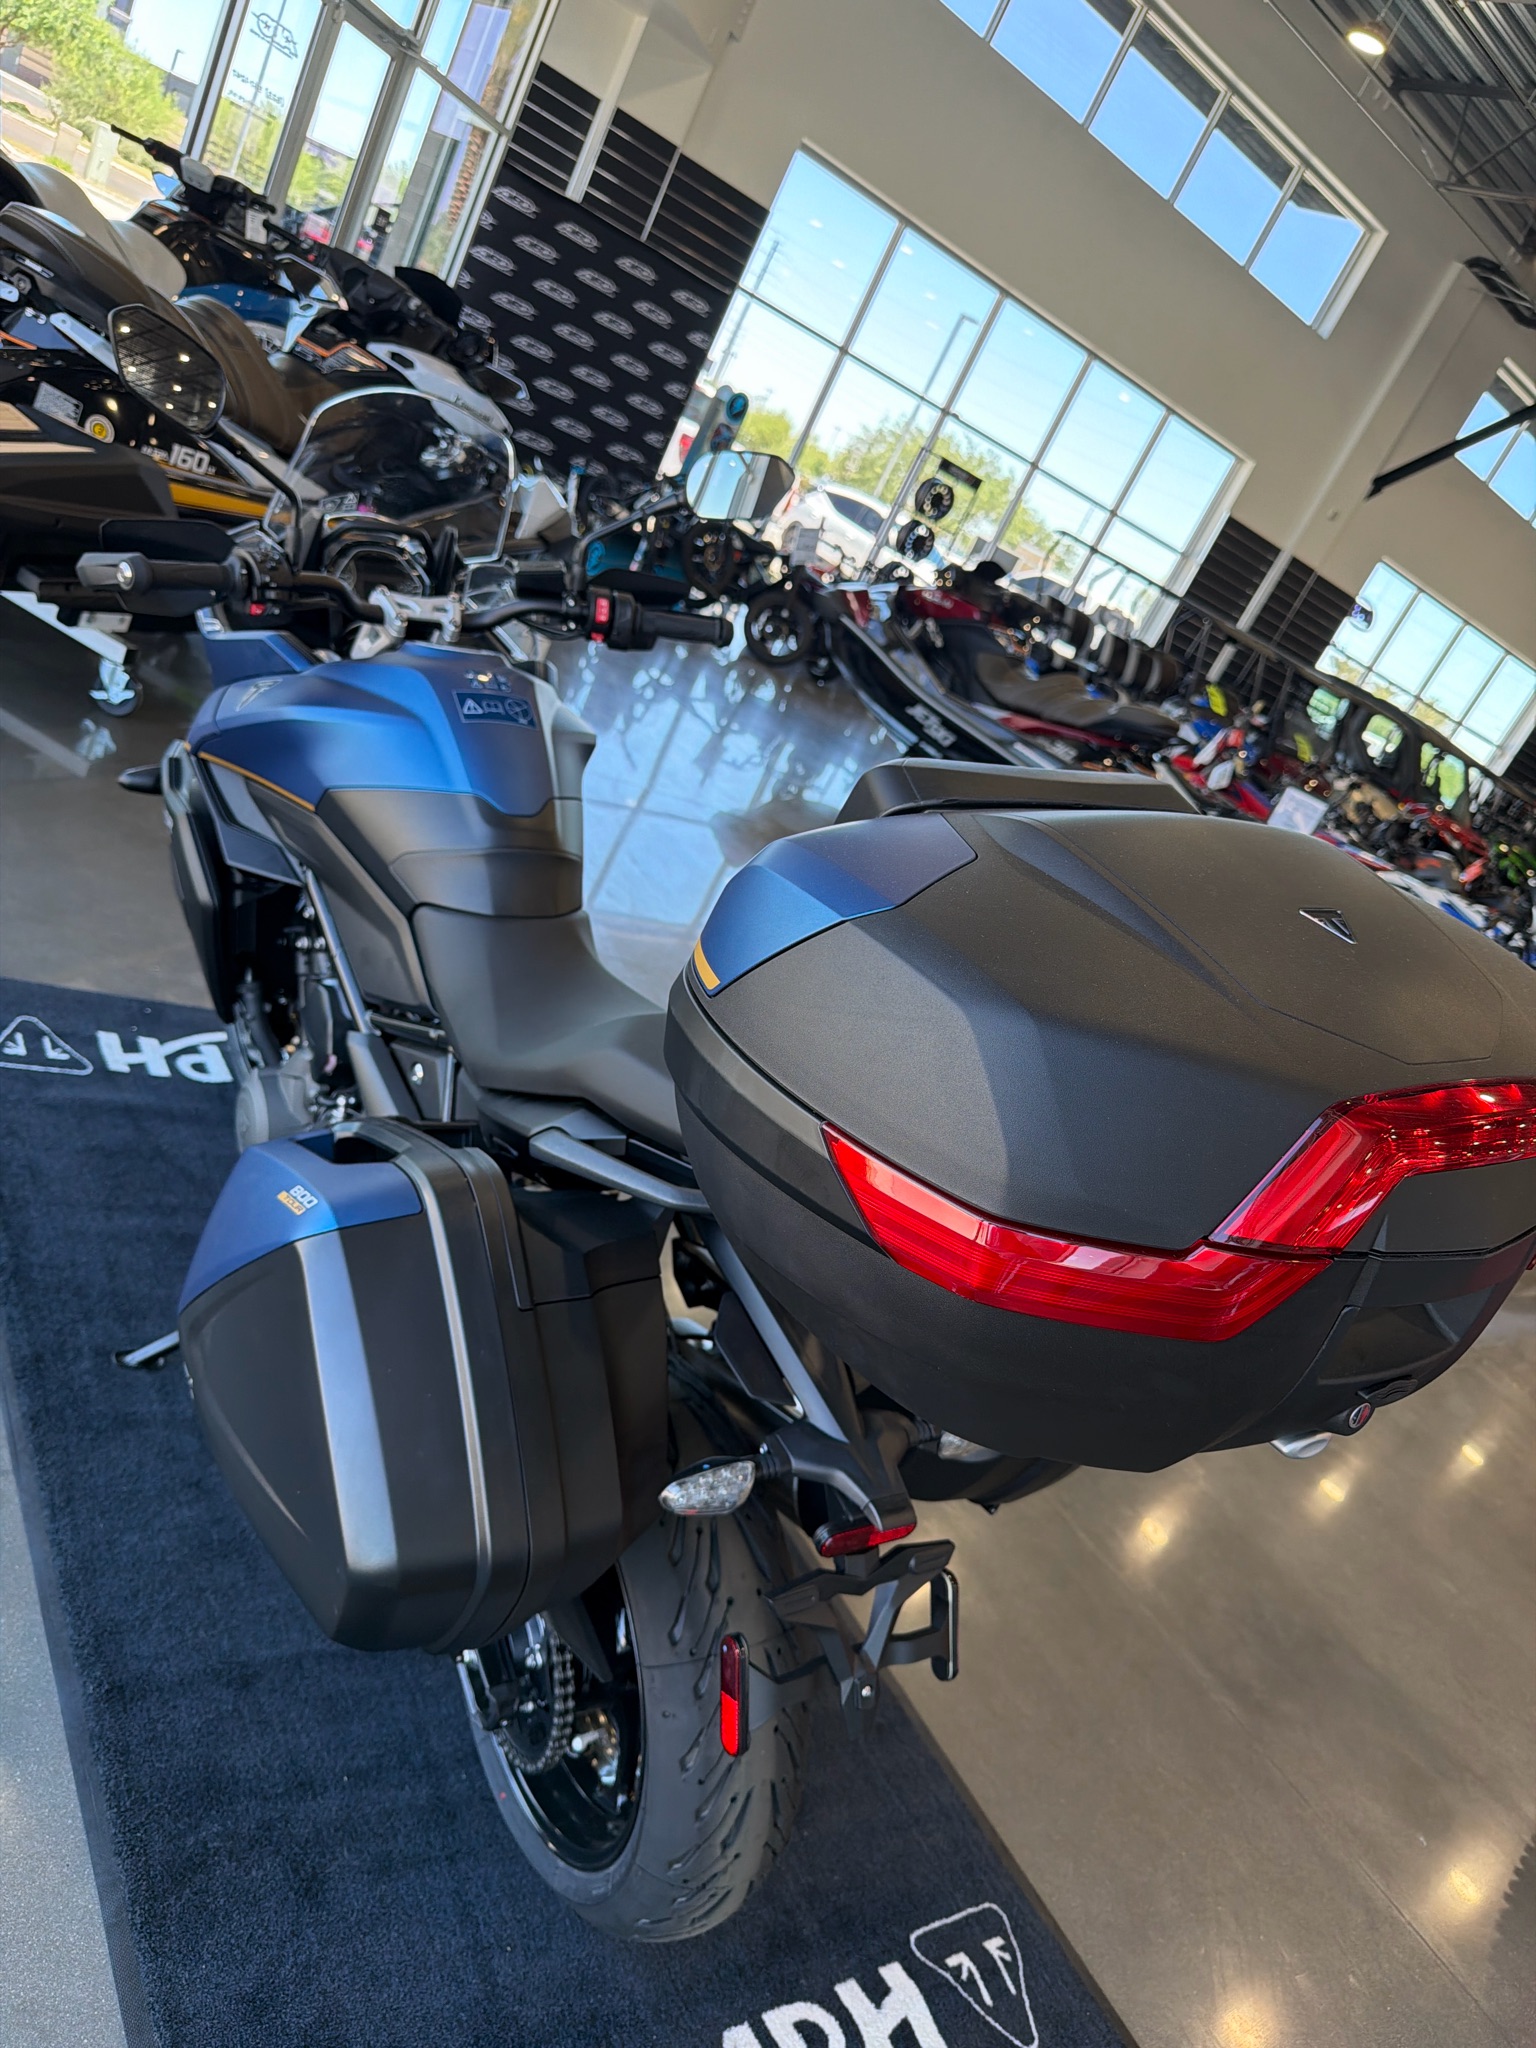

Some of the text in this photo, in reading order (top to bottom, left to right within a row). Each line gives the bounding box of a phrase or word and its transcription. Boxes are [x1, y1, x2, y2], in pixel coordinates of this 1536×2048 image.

[169, 442, 211, 476] 160
[281, 1192, 304, 1213] TOUR
[289, 1184, 319, 1209] 800
